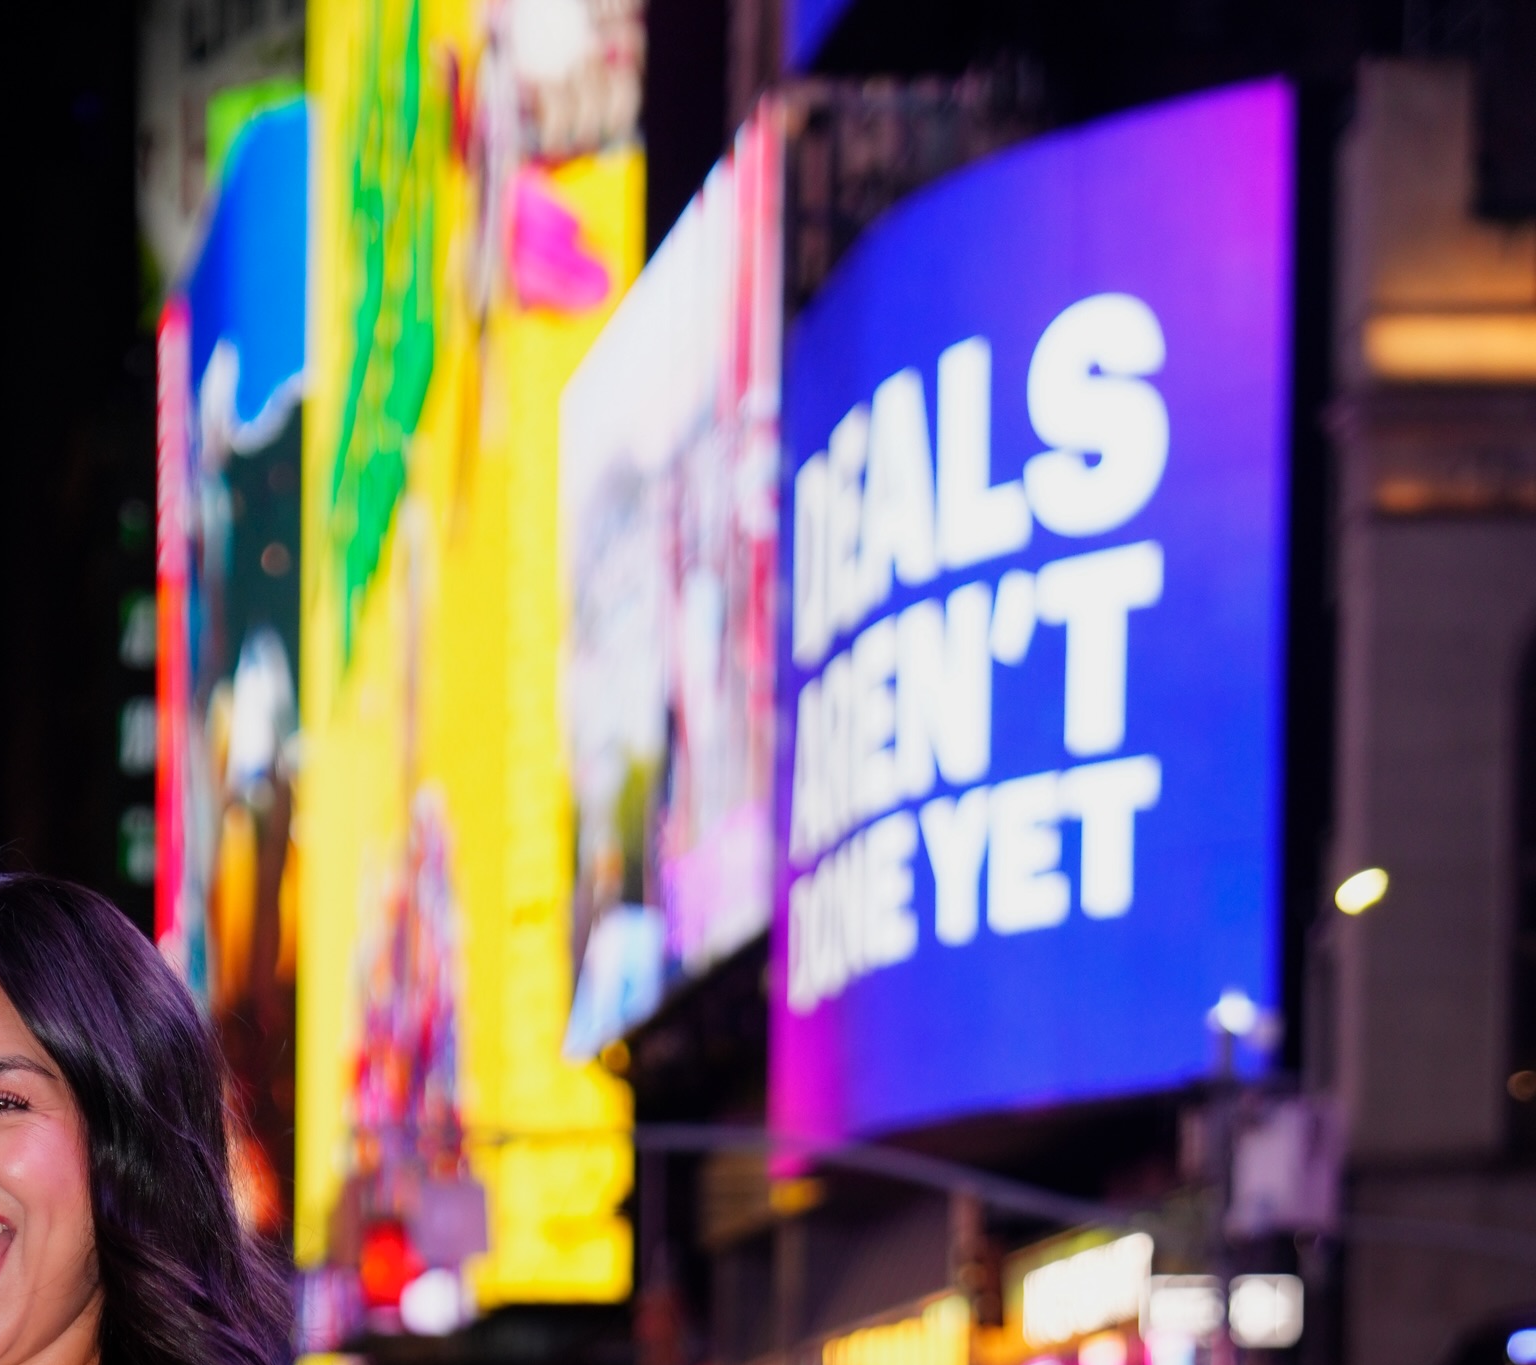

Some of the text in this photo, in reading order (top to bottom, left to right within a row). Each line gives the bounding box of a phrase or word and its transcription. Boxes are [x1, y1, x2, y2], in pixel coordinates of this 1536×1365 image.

[792, 291, 1170, 669] DEALS
[788, 540, 1165, 871] AREN'T
[786, 753, 1163, 1016] DONE YET
